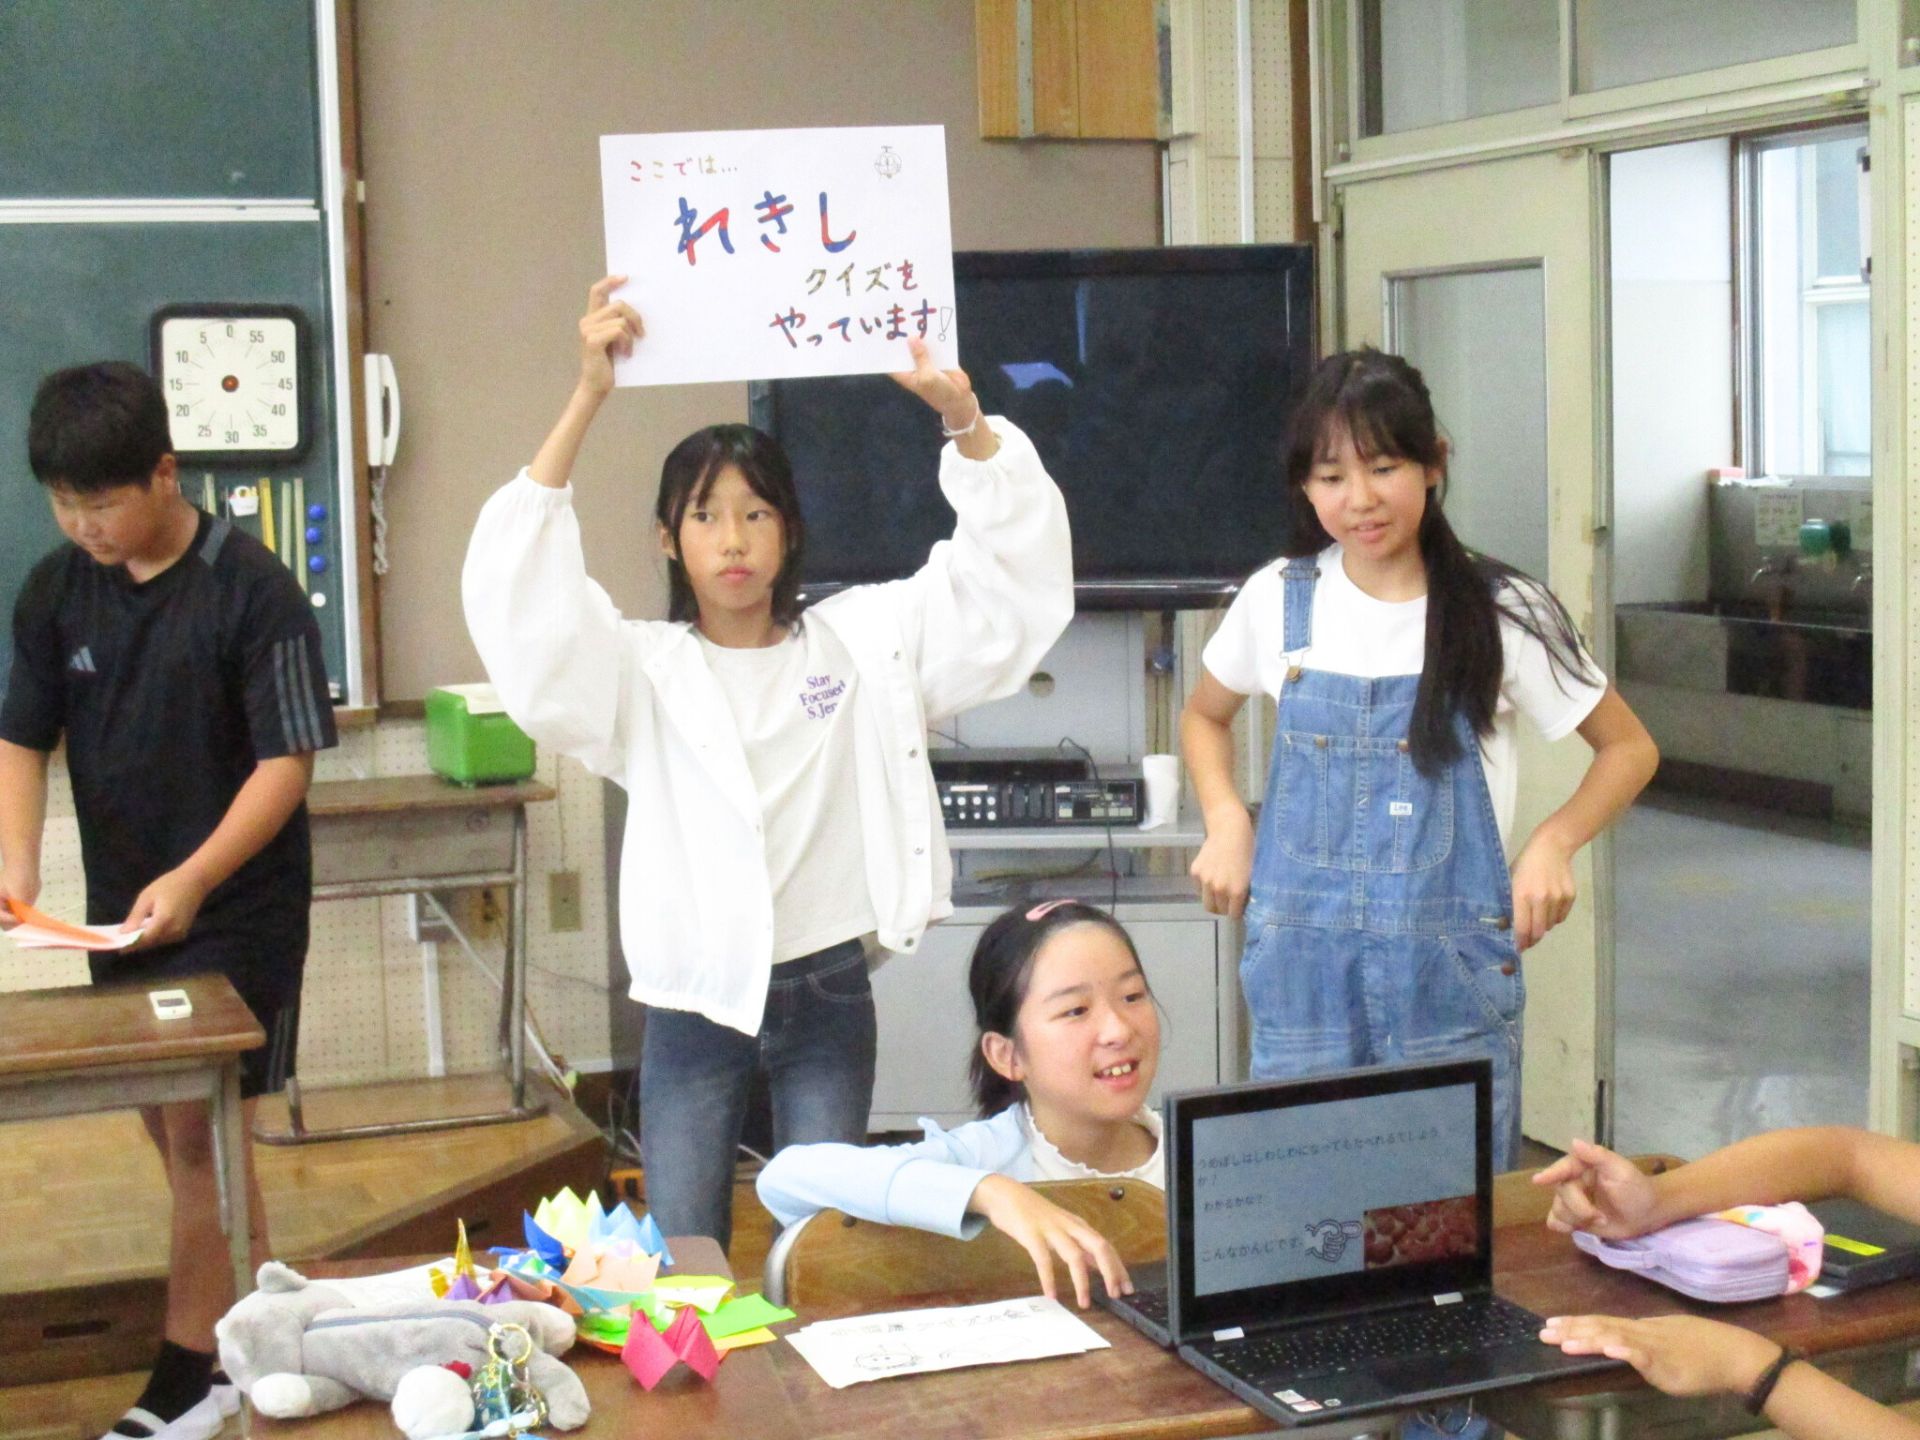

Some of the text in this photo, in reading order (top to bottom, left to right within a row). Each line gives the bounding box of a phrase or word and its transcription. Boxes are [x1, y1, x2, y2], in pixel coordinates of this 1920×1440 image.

[674, 190, 857, 266] れきし
[806, 258, 918, 297] クイズを
[226, 325, 234, 338] 0
[250, 331, 264, 343] 55
[200, 332, 207, 344] 5
[176, 351, 189, 363] 10
[271, 351, 285, 363] 50
[170, 378, 182, 390] 15
[278, 378, 293, 390] 45
[176, 405, 190, 417] 20
[271, 404, 286, 416] 40
[198, 426, 212, 438] 25
[225, 431, 239, 443] 30
[253, 425, 268, 437] 35
[806, 674, 831, 689] Stay
